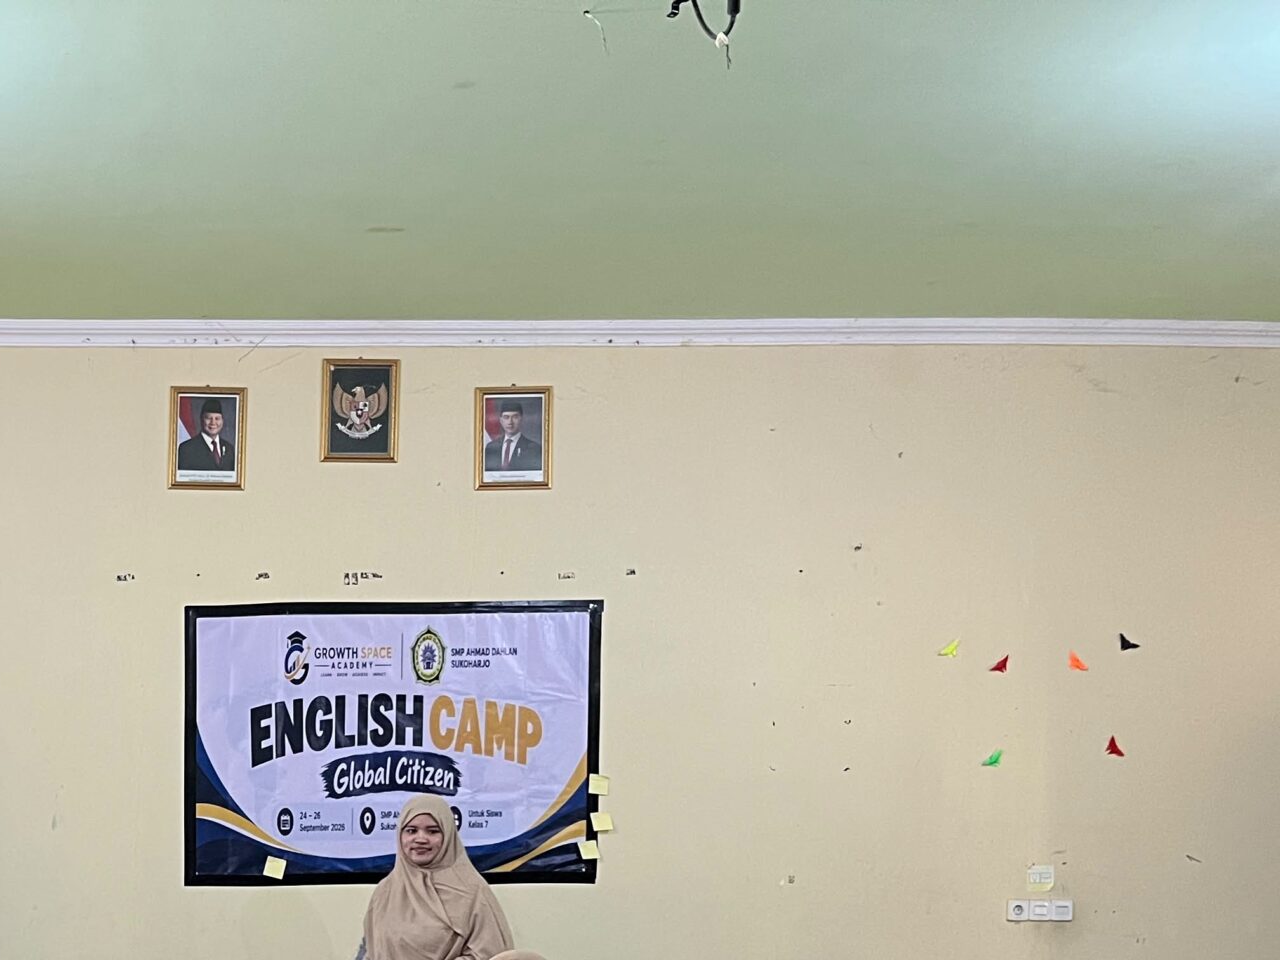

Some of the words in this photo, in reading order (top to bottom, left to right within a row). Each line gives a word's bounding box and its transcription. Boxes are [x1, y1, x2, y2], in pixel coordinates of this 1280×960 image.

[314, 647, 359, 660] GROWTH
[360, 647, 392, 659] SPACE
[450, 648, 465, 656] SMP
[466, 647, 490, 656] AHMAD
[330, 661, 374, 670] ACADEMY
[450, 659, 491, 668] SUKOHARJO
[250, 693, 424, 768] ENGLISH
[429, 695, 543, 765] CAMP
[333, 758, 391, 794] Global
[395, 756, 455, 790] Citizen
[299, 811, 307, 820] 24
[468, 809, 484, 817] Untuk
[299, 823, 330, 832] September
[468, 820, 483, 828] Kelas
